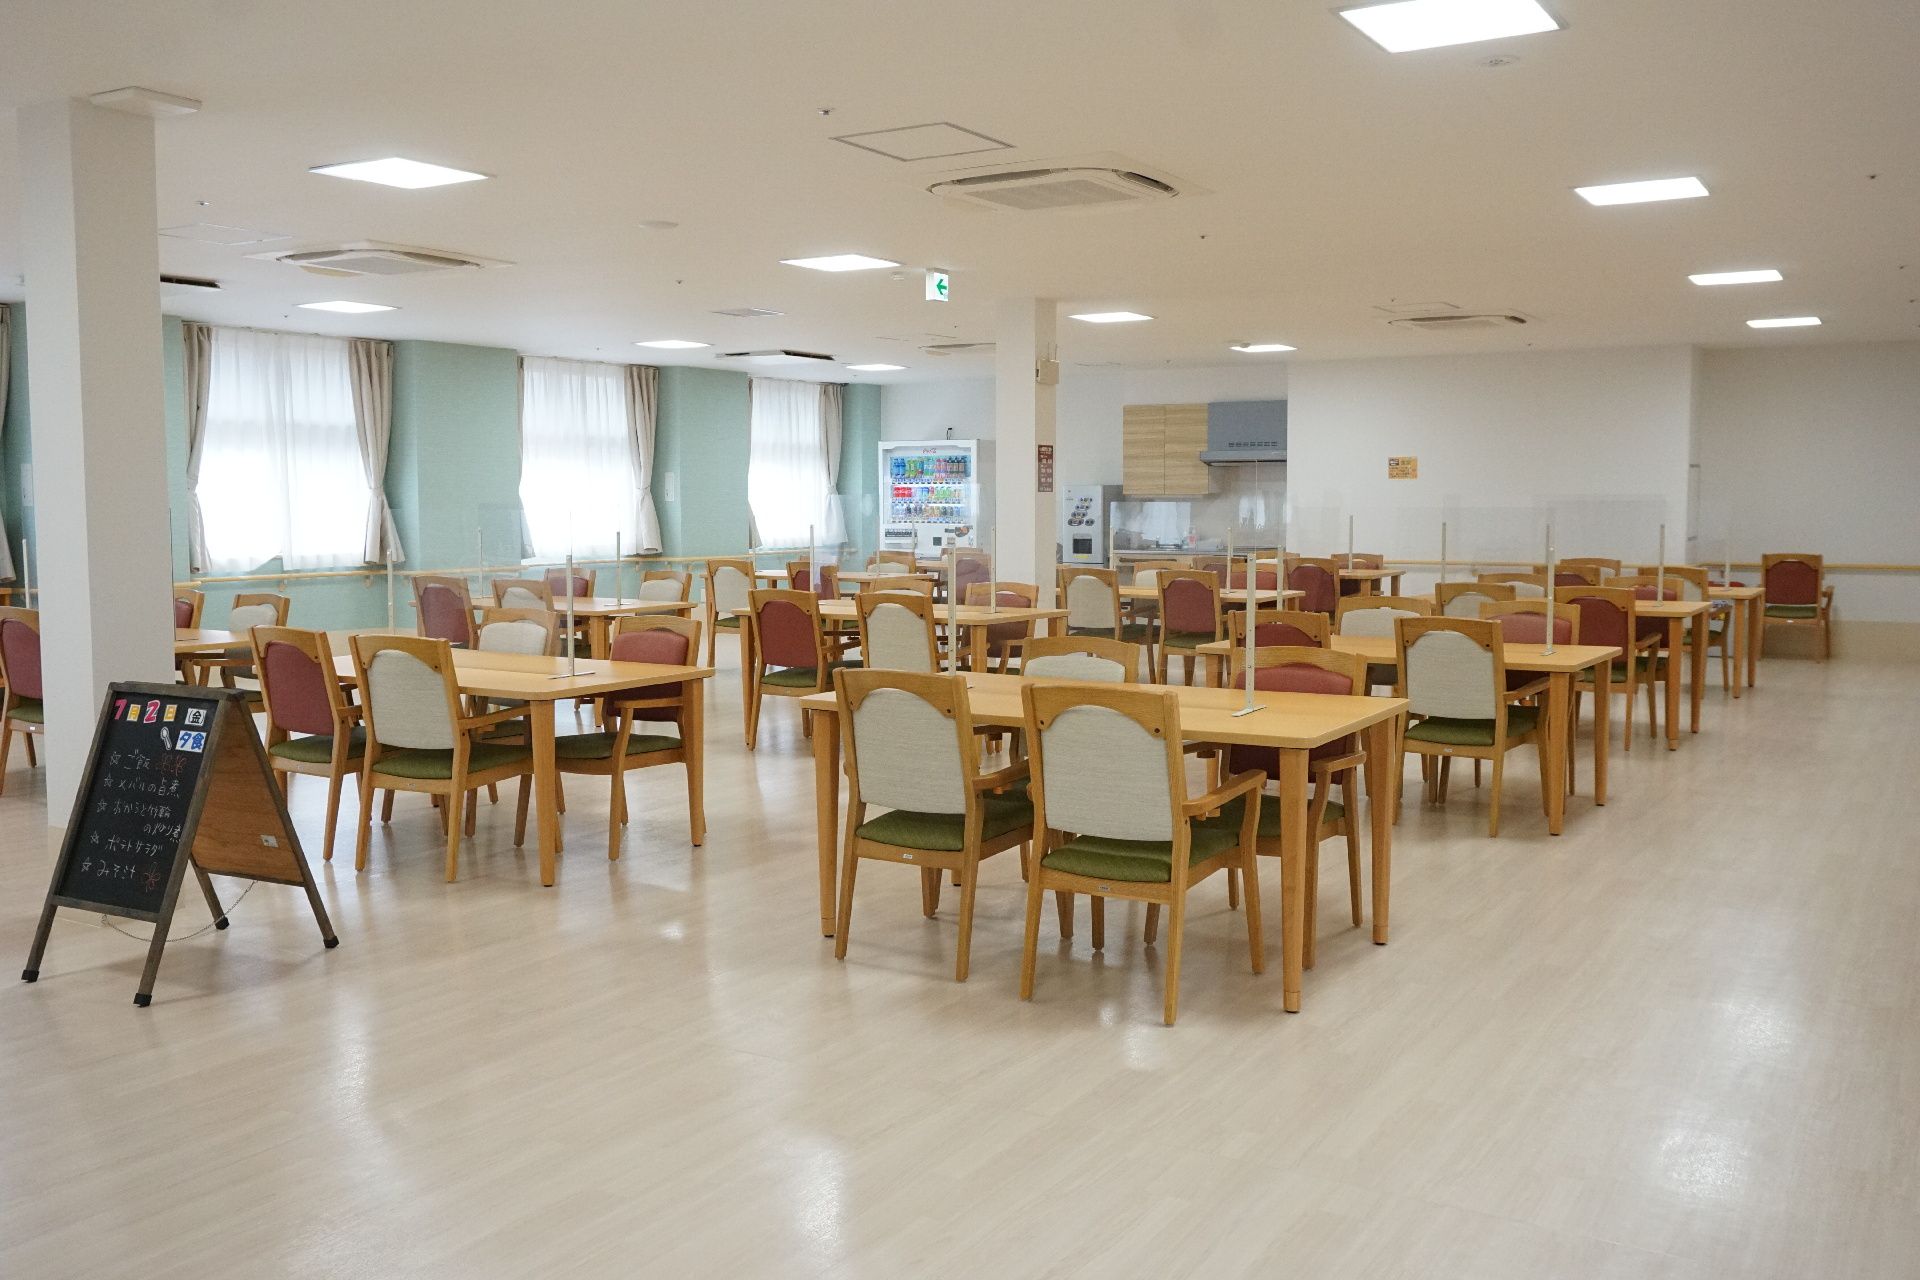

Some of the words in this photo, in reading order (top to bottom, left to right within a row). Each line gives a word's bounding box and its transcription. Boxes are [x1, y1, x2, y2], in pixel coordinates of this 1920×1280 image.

[180, 731, 204, 750] 夕食
[123, 749, 151, 770] ご飯
[105, 834, 163, 857] ポテトサラダ
[96, 860, 136, 879] みそ汁
